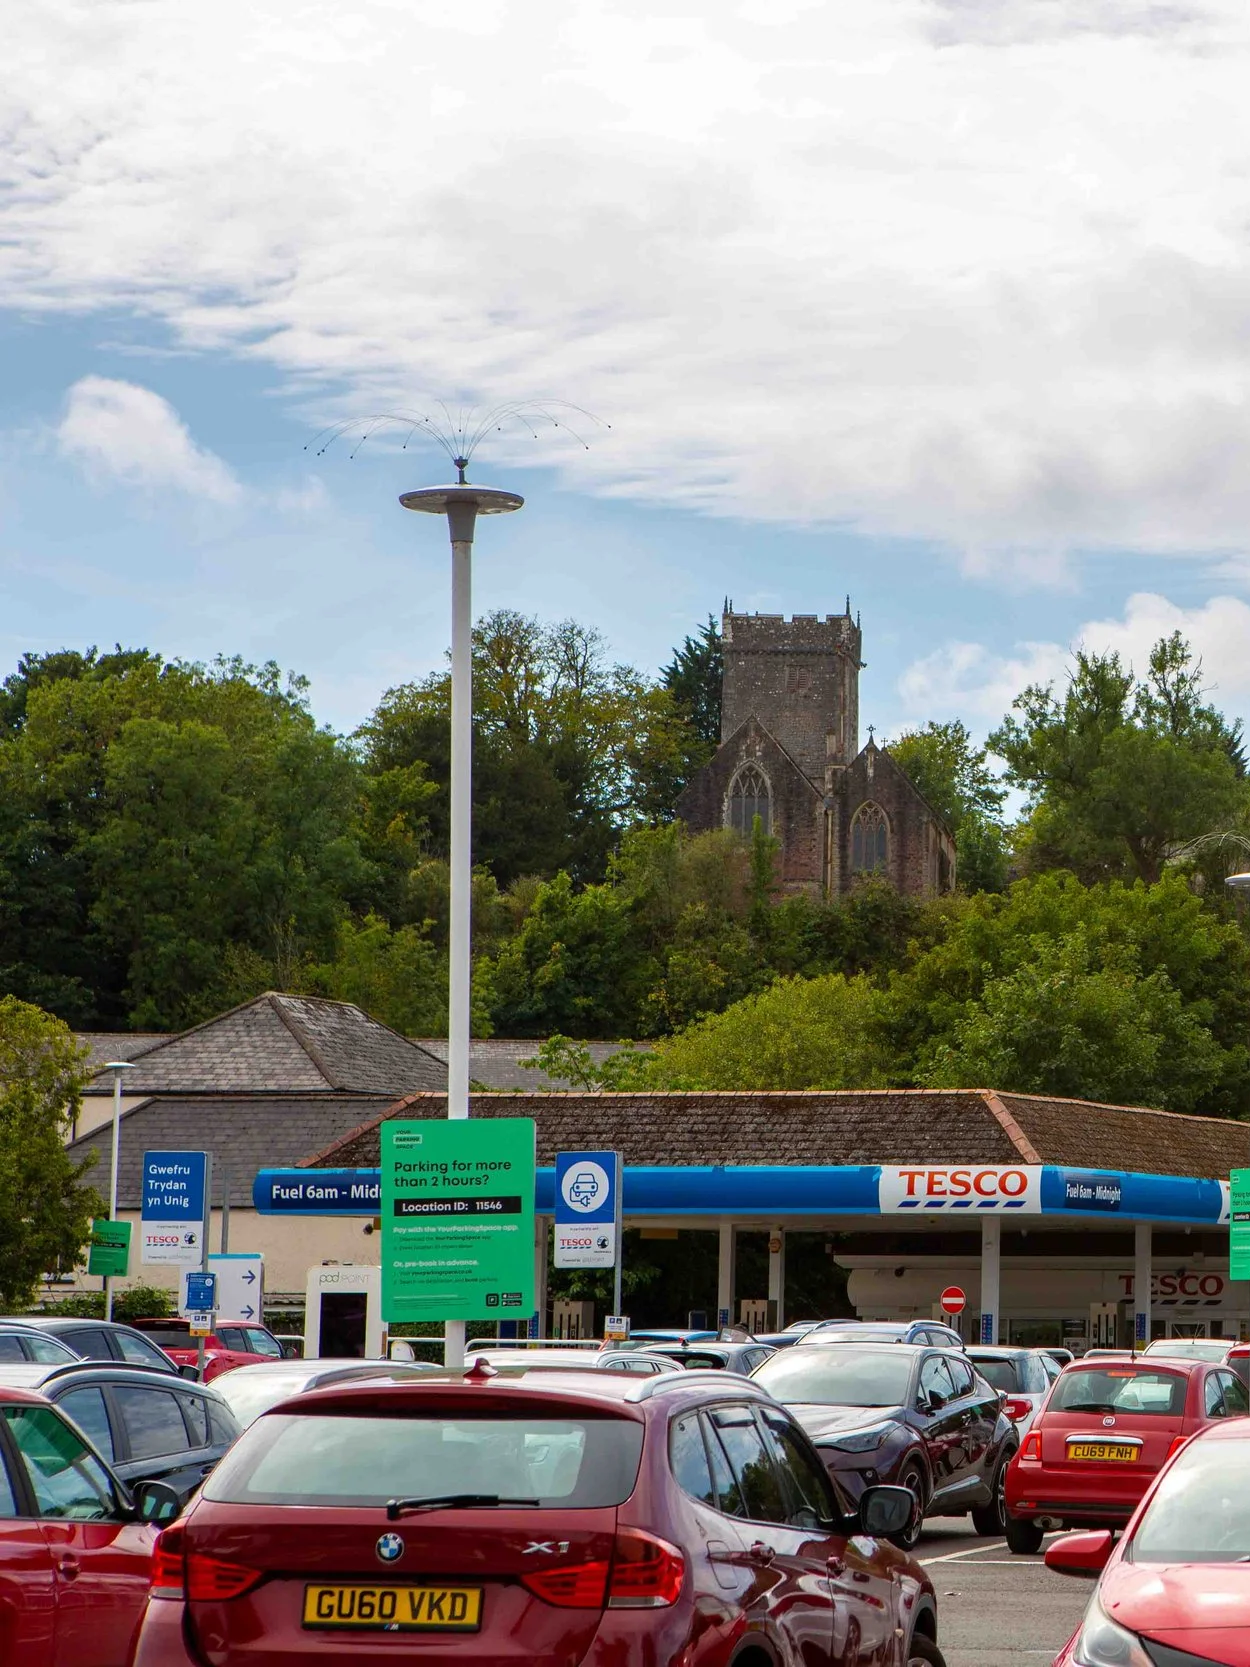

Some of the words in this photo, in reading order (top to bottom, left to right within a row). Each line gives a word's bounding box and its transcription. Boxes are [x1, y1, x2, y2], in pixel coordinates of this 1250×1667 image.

[149, 1164, 190, 1175] Gwefru
[394, 1160, 448, 1174] Parking
[452, 1160, 472, 1171] for
[476, 1161, 512, 1171] more
[148, 1179, 187, 1193] Trydan
[394, 1176, 427, 1187] than
[431, 1176, 438, 1187] 2
[442, 1174, 490, 1187] hours?
[898, 1170, 1028, 1197] TESCO
[272, 1184, 303, 1199] Fuel
[306, 1185, 338, 1199] 6am
[1066, 1183, 1079, 1199] Fuel
[1079, 1185, 1092, 1199] 6am
[1095, 1185, 1122, 1205] Midnight
[147, 1198, 160, 1207] yn
[164, 1196, 189, 1208] Unig
[402, 1202, 451, 1213] Location
[454, 1202, 469, 1211] ID:
[476, 1201, 503, 1211] 11546
[146, 1235, 179, 1243] TESCO
[559, 1238, 592, 1246] TESCO
[1074, 1445, 1106, 1458] CU69
[1107, 1447, 1133, 1459] FNH
[521, 1541, 570, 1554] X1
[316, 1589, 397, 1619] GU60
[408, 1591, 468, 1621] VKD
